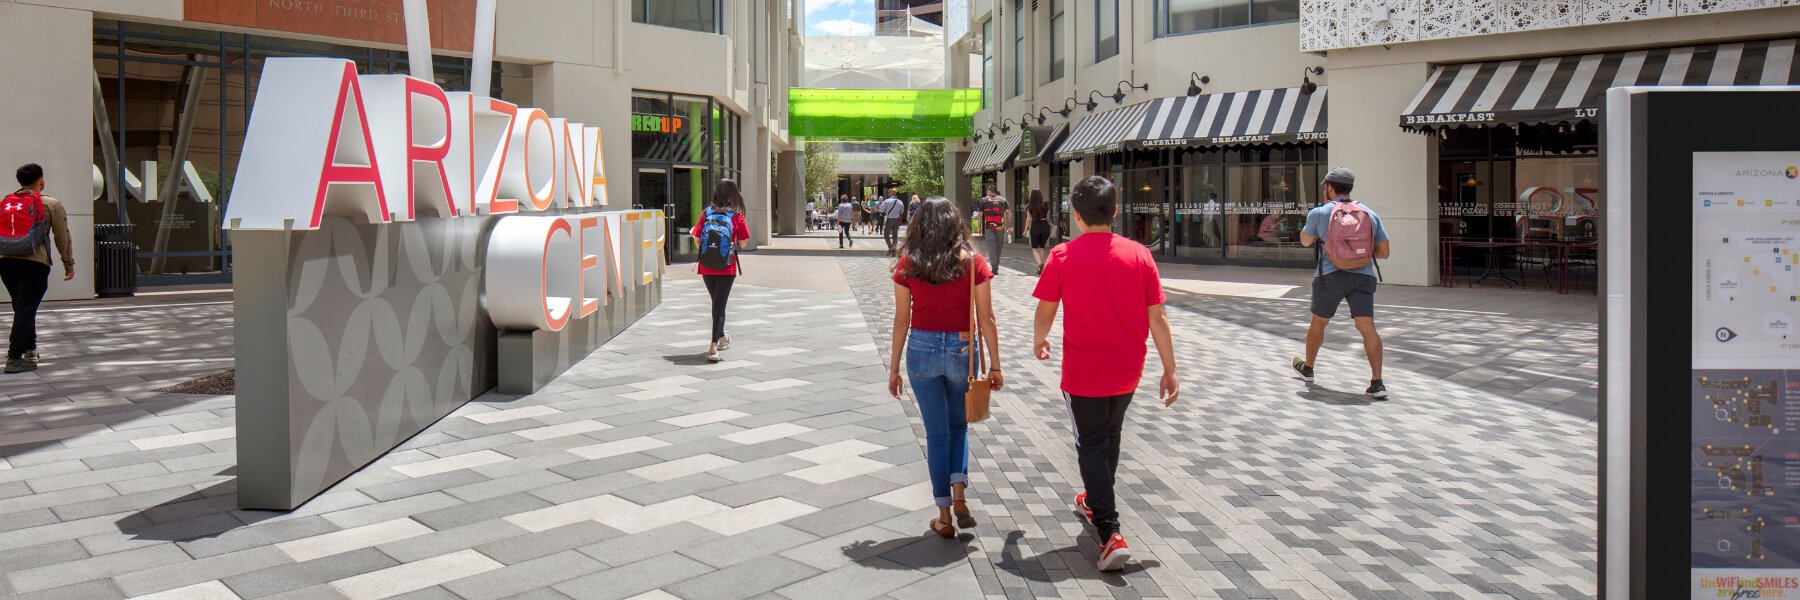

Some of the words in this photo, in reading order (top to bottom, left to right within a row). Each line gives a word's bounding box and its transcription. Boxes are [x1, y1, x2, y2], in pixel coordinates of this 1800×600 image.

[268, 0, 323, 14] NORTH
[335, 5, 378, 21] THIRD
[1406, 112, 1495, 124] BREAKFAST
[309, 60, 608, 229] ARIZONA
[1142, 138, 1187, 147] CATERING
[1212, 134, 1270, 144] BREAKFAST
[1735, 169, 1784, 177] ARIZONA
[1462, 203, 1489, 215] cakes
[542, 209, 667, 332] CENTER
